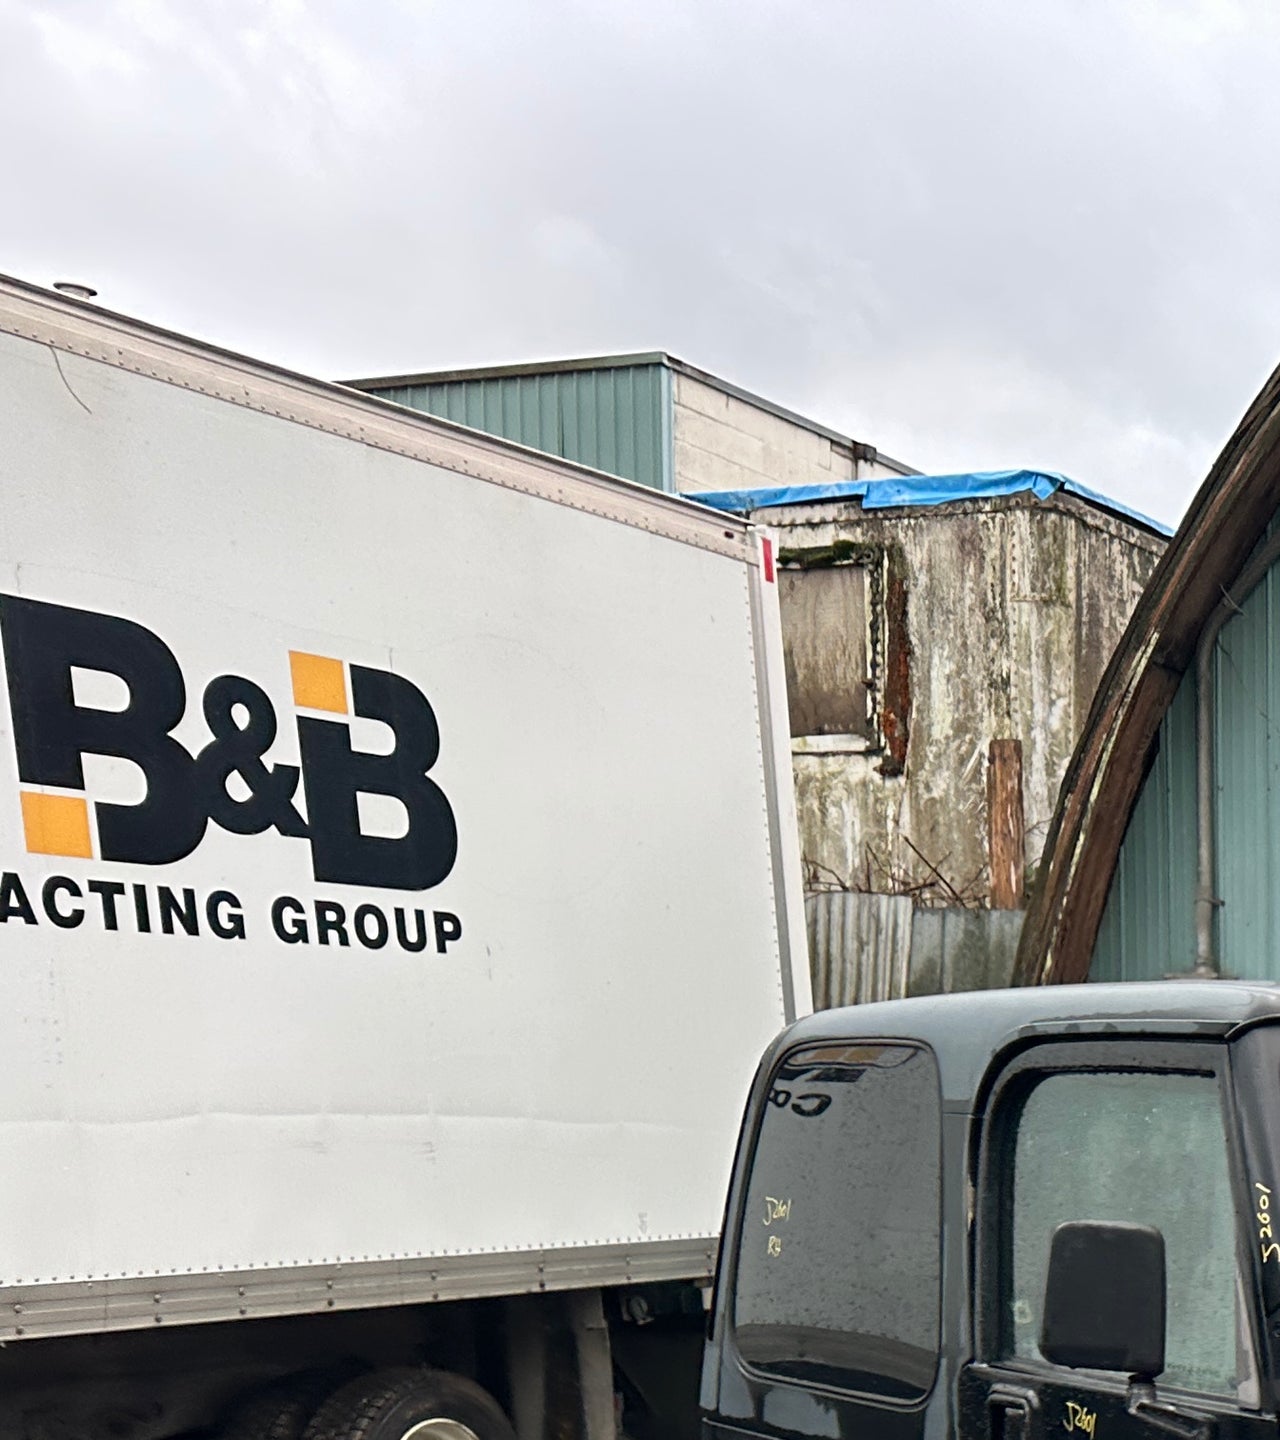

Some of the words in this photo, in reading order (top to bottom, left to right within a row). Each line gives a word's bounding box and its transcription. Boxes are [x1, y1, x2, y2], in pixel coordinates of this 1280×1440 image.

[0, 592, 458, 892] B&B
[0, 872, 245, 939] ACTING
[272, 895, 463, 954] GROUP
